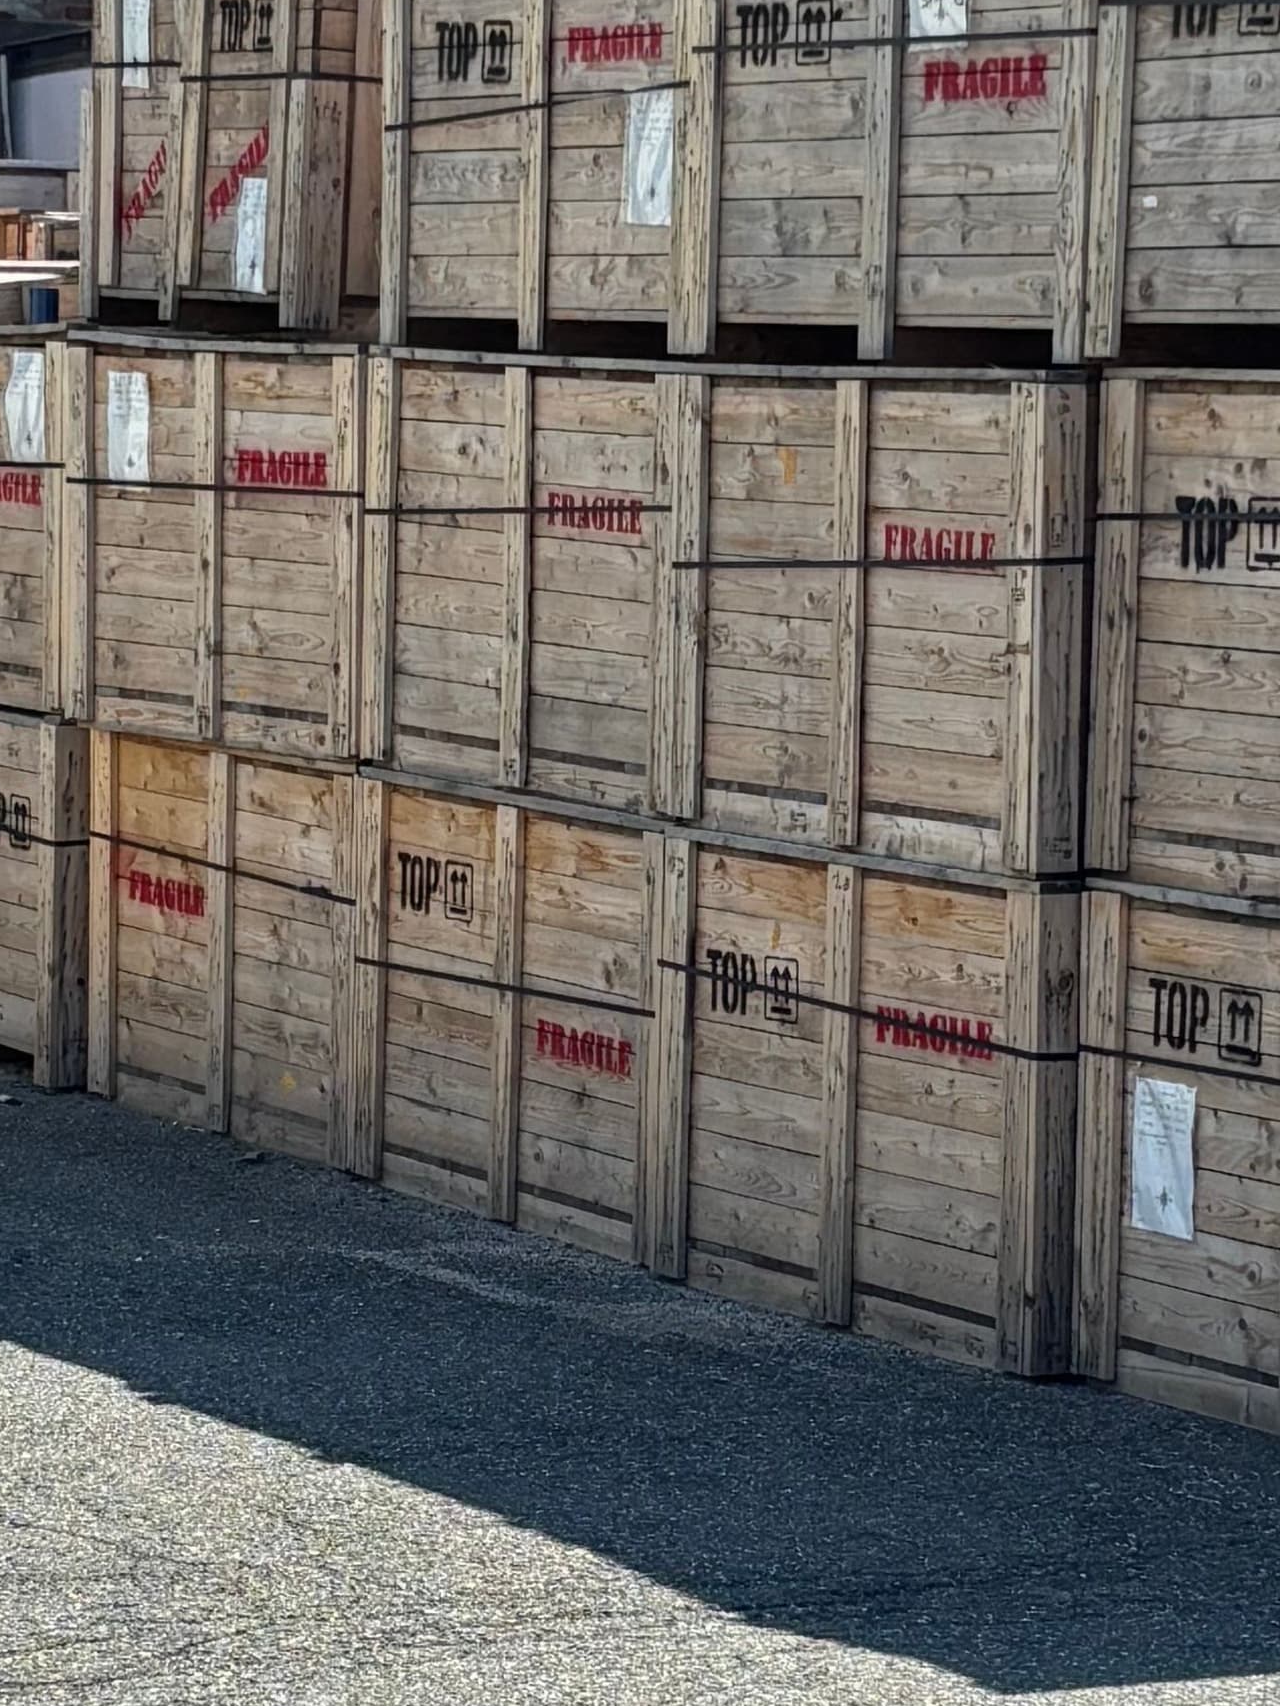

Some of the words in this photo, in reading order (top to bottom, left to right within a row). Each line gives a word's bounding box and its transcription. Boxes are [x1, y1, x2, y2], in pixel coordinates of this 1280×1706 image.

[436, 21, 478, 82] TOP
[568, 23, 663, 63] FRAGILE
[736, 4, 790, 67] TOP
[923, 54, 1048, 101] FRAGILE
[238, 450, 329, 488] FRAGILE
[547, 492, 643, 535] FRAGILE
[1175, 495, 1239, 571] TOP
[884, 524, 997, 570] FRAGILE
[129, 869, 205, 917] FRAGILE
[398, 852, 445, 916] TOP
[706, 948, 758, 1016] TOP
[876, 1004, 995, 1062] FRAGILE
[1150, 977, 1210, 1054] TOP
[535, 1018, 633, 1079] FRAGILE
